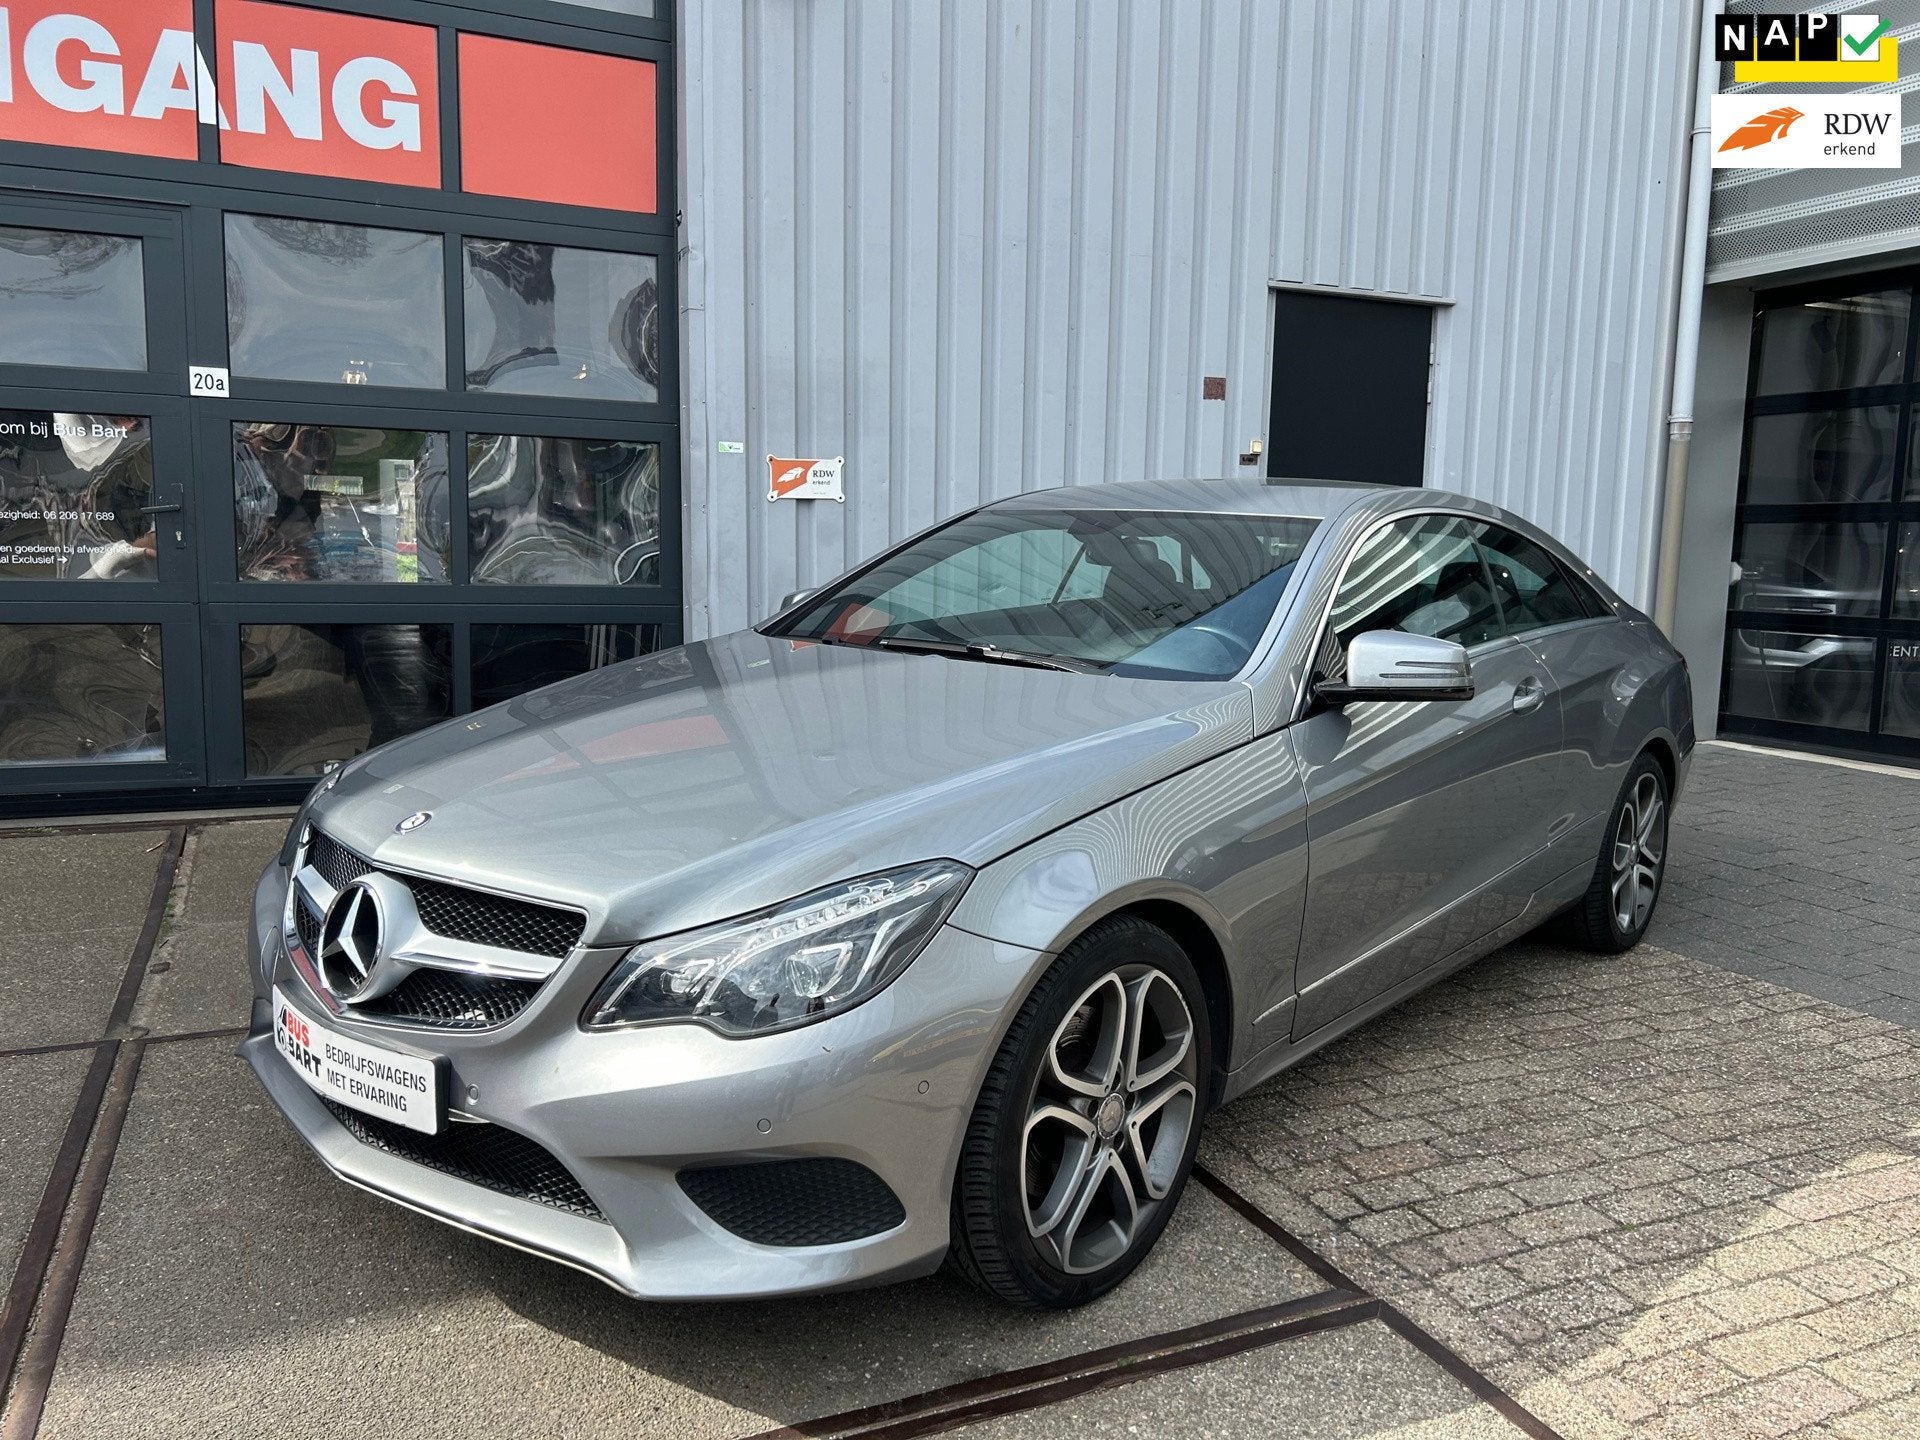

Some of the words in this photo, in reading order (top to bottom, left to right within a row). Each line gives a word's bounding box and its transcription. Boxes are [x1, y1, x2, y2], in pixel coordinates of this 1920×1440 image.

[194, 373, 225, 391] 20a
[30, 422, 48, 439] bij
[53, 423, 86, 437] Bus
[91, 424, 128, 439] Bart
[812, 469, 835, 478] RDW
[43, 510, 57, 520] 06
[59, 511, 79, 520] 206
[80, 511, 93, 520] 17
[95, 511, 115, 521] 689
[14, 544, 62, 555] goederen
[63, 544, 75, 555] bij
[11, 555, 55, 564] Exclusief
[1889, 645, 1920, 657] ENT
[287, 1009, 311, 1048] BUS
[287, 1034, 321, 1077] BART
[325, 1043, 427, 1093] BEDRIJFSWAGENS
[326, 1068, 346, 1091] MET
[350, 1079, 408, 1113] ERVARING
